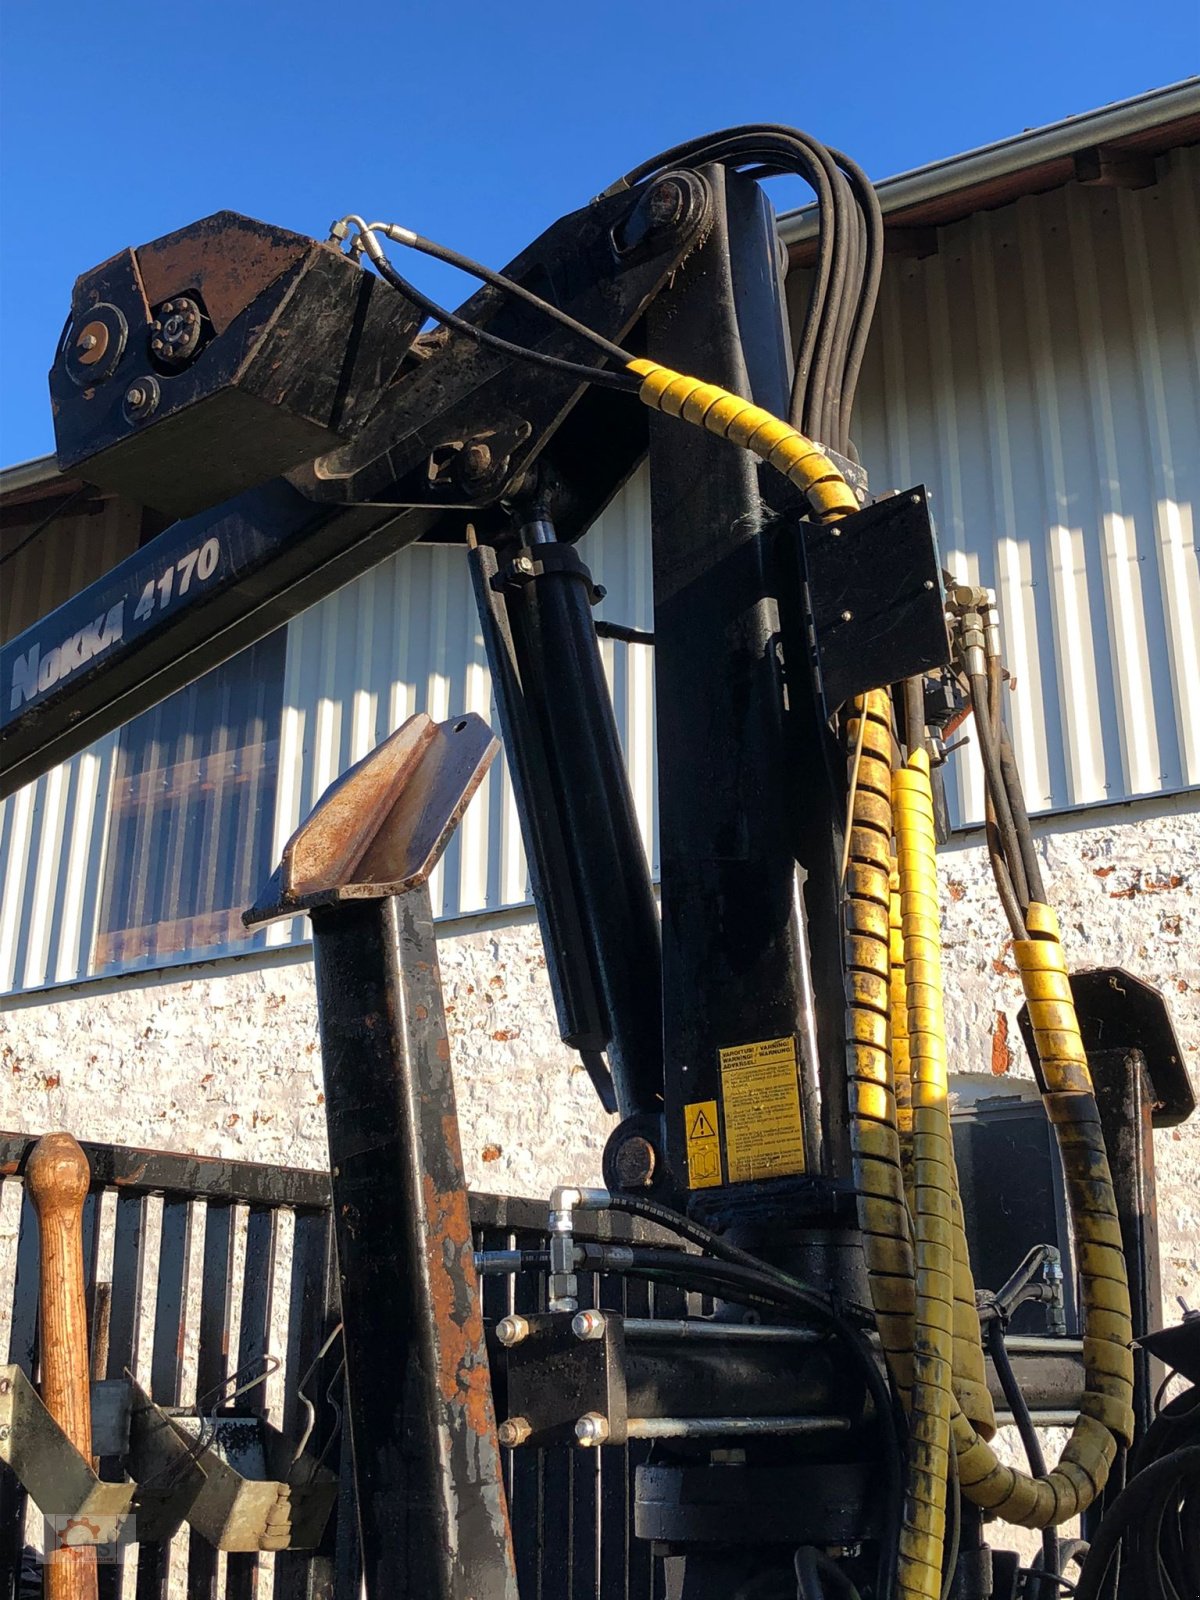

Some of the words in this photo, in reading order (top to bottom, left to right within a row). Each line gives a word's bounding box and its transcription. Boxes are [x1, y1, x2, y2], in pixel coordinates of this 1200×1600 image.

[133, 537, 220, 622] 4170
[722, 1047, 755, 1058] VAROITUS!
[760, 1041, 790, 1051] VARNING!
[722, 1054, 753, 1064] WARNING!
[759, 1047, 793, 1057] WARNUNG!
[723, 1059, 757, 1070] ADVARSEL!
